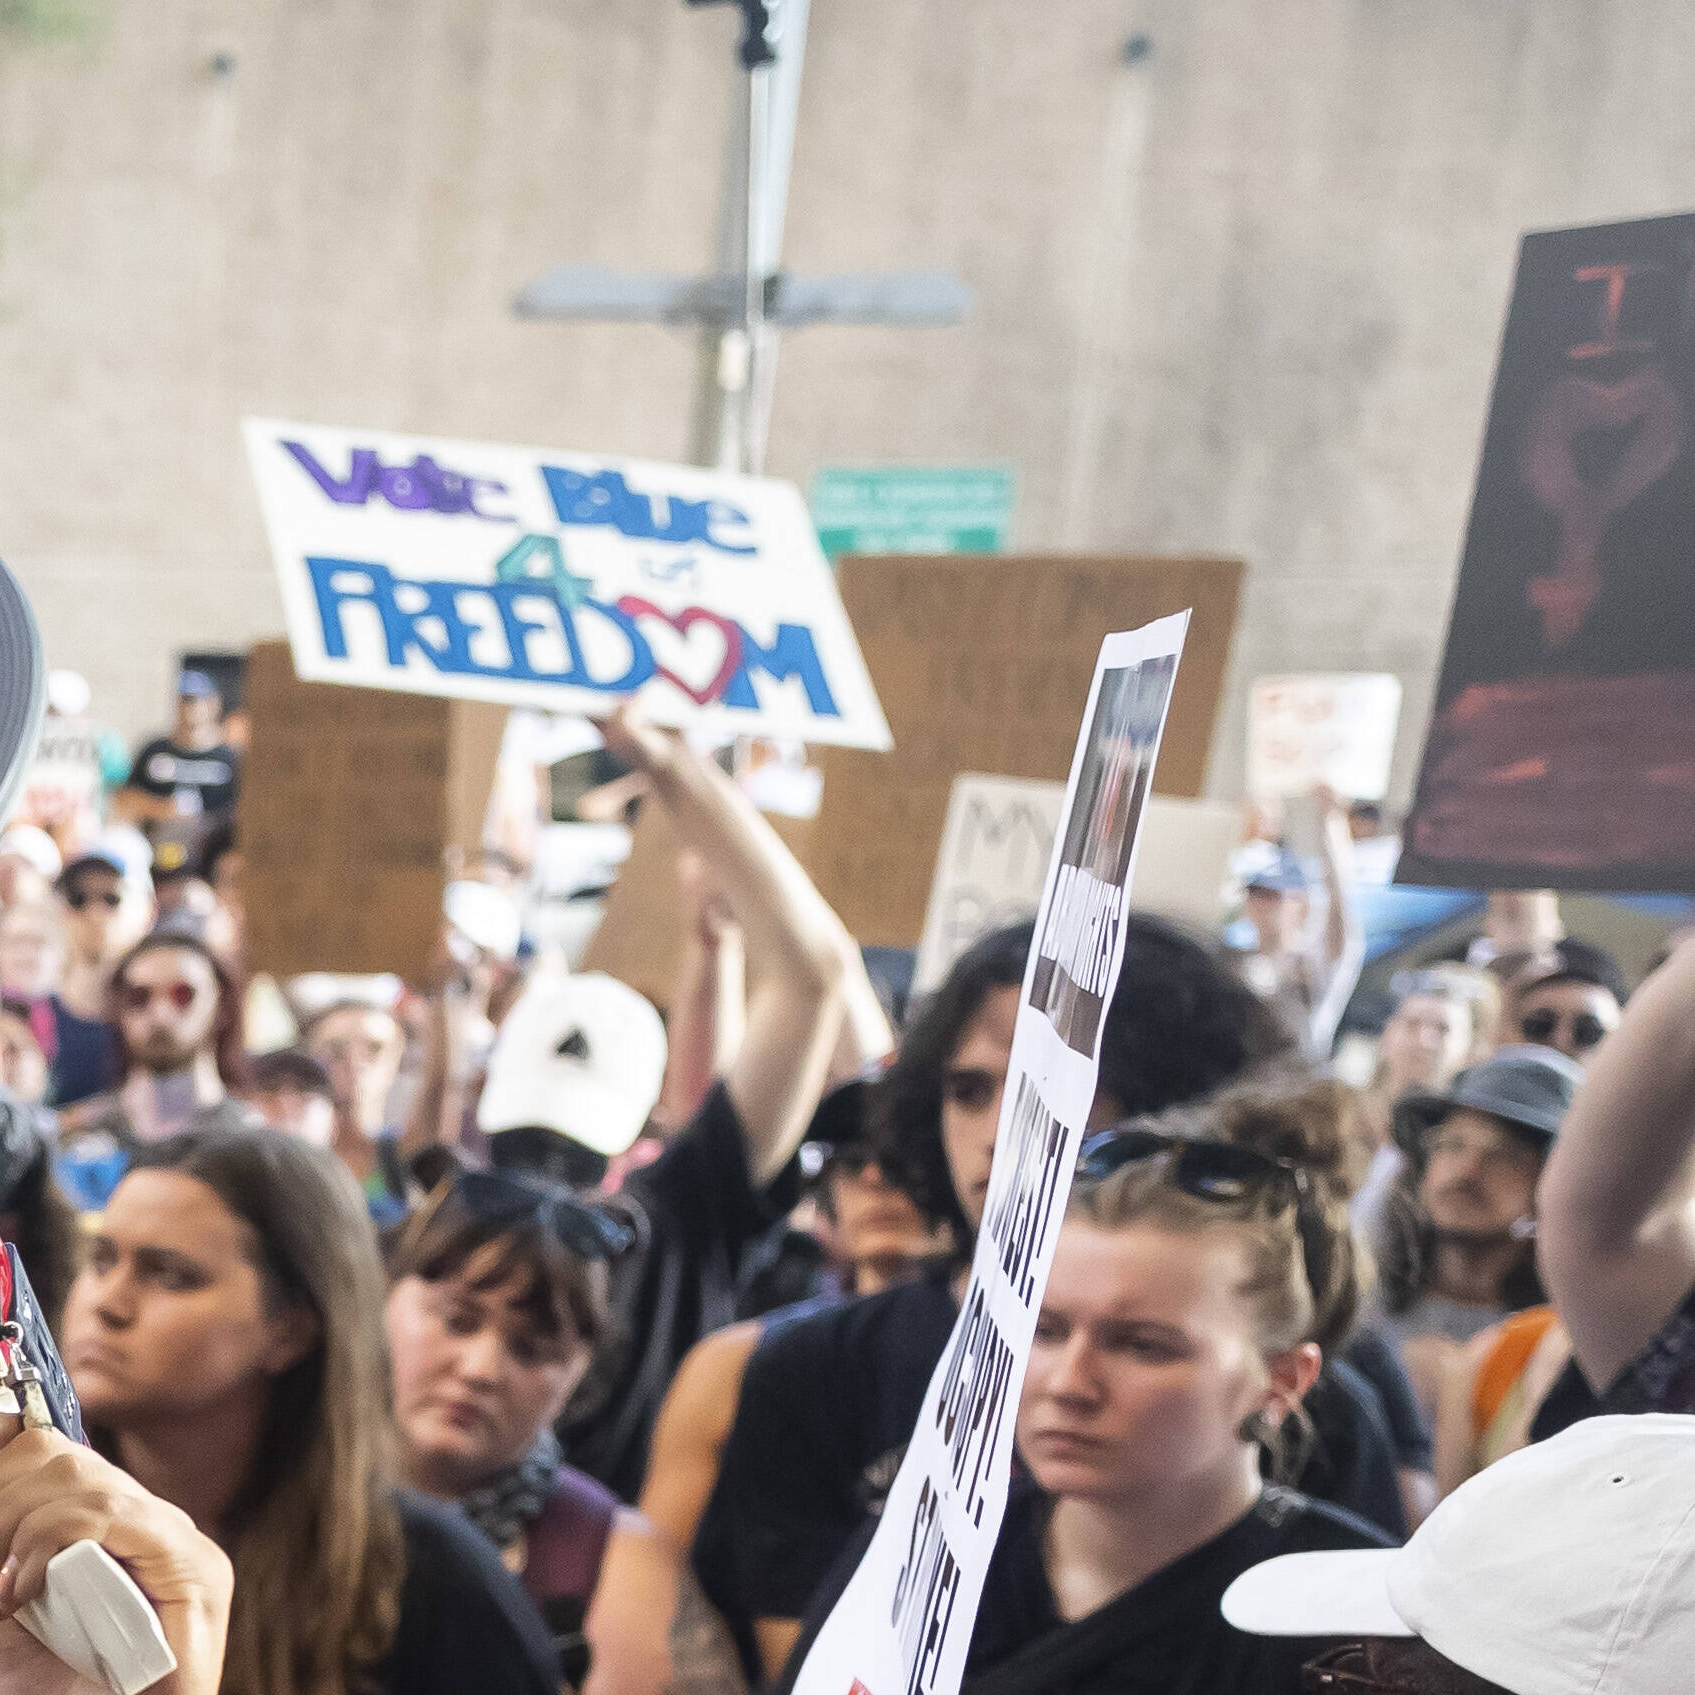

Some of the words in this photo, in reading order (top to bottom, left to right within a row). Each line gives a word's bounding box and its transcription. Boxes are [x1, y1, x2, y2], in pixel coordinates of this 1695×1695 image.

[280, 439, 518, 522] Vote
[540, 464, 758, 557] Blue
[495, 533, 595, 602] 4
